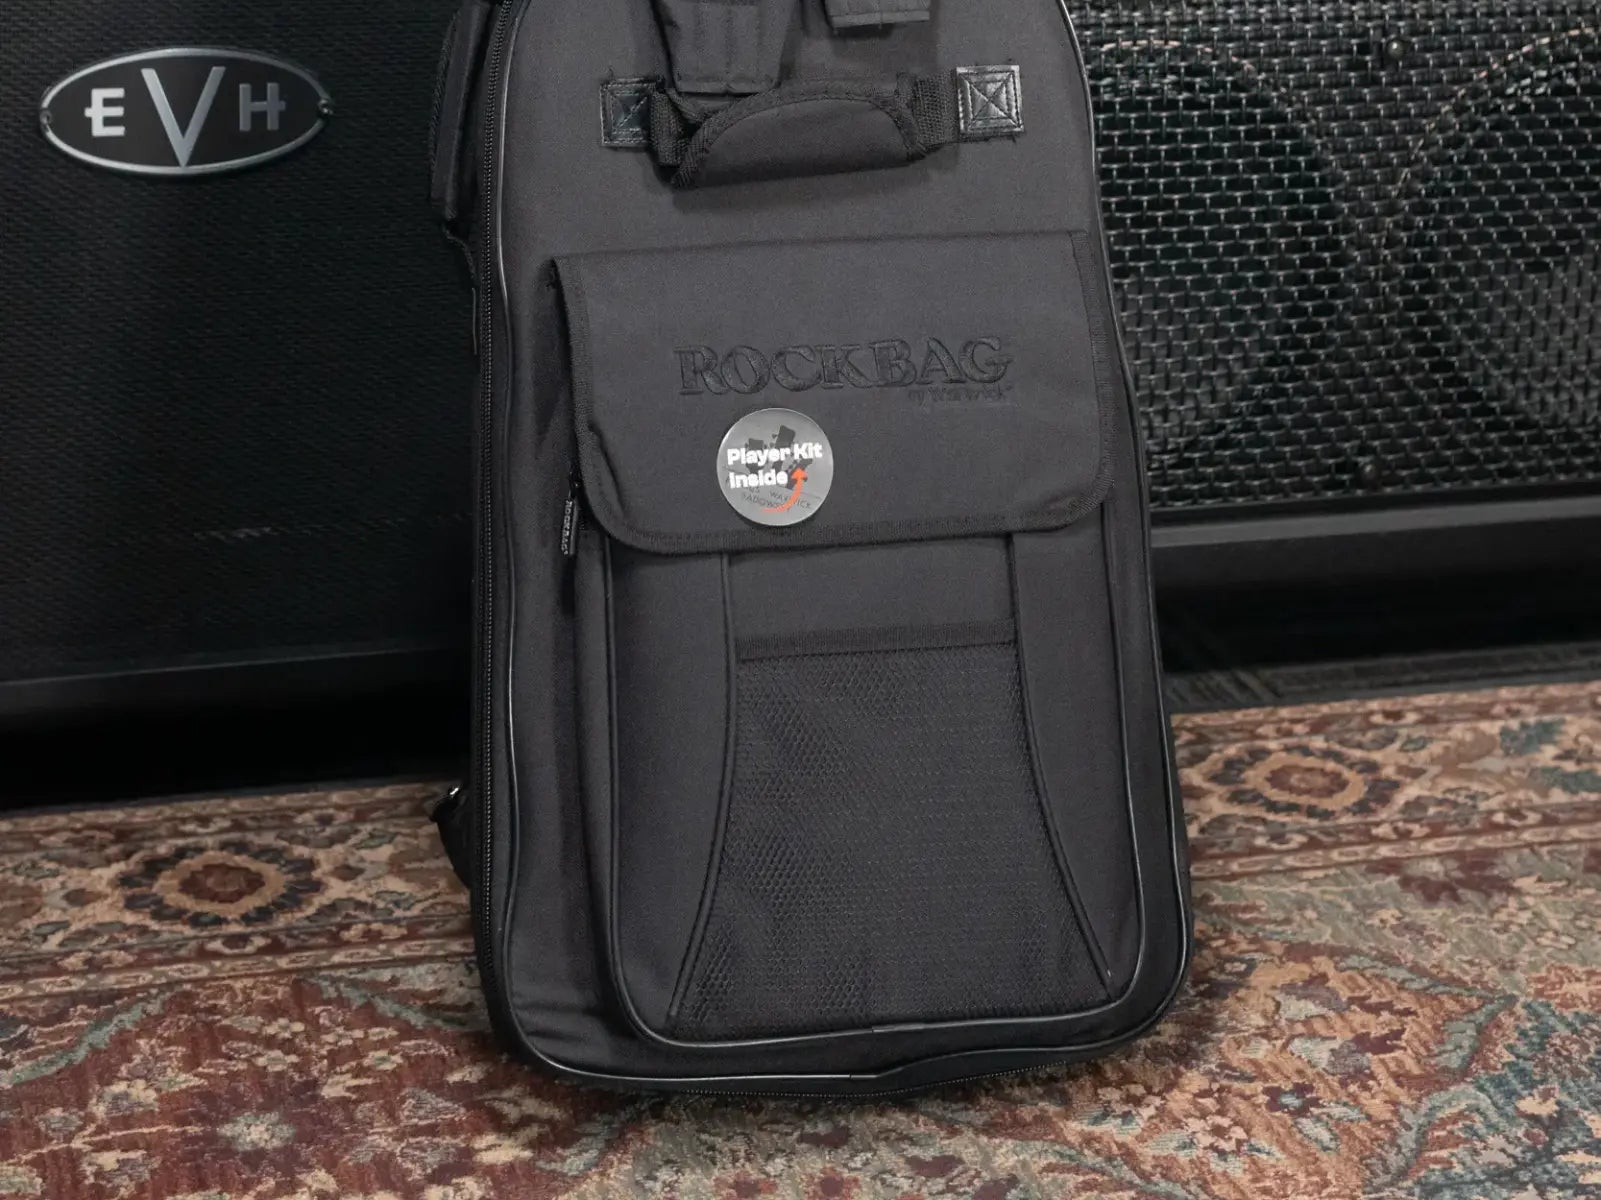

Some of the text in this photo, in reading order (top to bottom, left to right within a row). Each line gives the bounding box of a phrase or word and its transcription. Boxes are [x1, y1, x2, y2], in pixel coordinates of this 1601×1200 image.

[673, 336, 1014, 395] ROCKBAG
[727, 441, 823, 466] Player Kit
[729, 469, 789, 489] Inside
